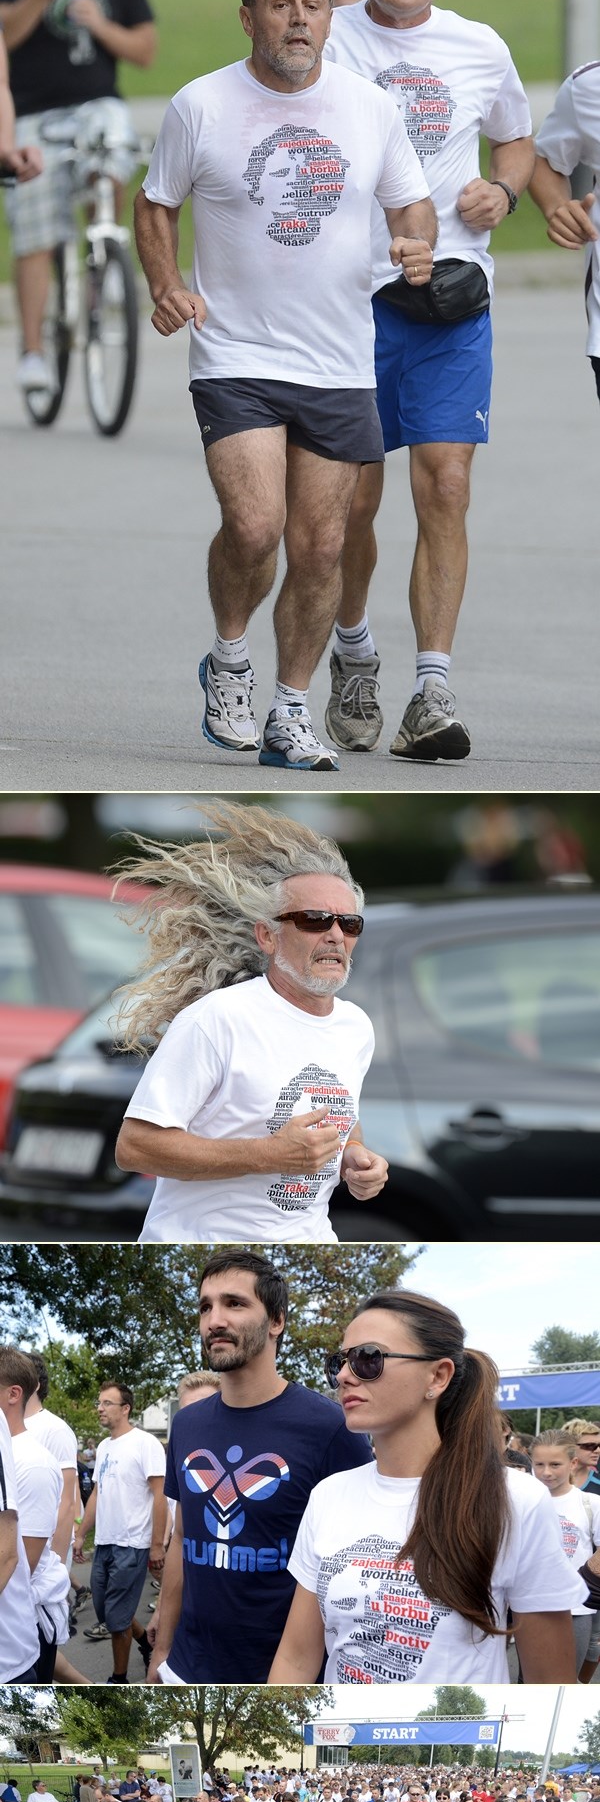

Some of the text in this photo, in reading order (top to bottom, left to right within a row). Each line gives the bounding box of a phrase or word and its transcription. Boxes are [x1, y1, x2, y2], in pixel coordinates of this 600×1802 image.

[391, 77, 443, 85] zajedničkim
[401, 84, 439, 93] working
[420, 105, 448, 113] borbu
[420, 123, 450, 131] protiv
[278, 138, 333, 148] zajedničkim
[287, 146, 328, 155] working
[301, 165, 340, 175] u borbu
[312, 182, 344, 194] protiv
[280, 219, 307, 228] raka
[303, 1085, 350, 1096] zajedničkim
[310, 1095, 346, 1108] working
[330, 1108, 348, 1116] belief
[284, 1183, 309, 1192] raka
[289, 1190, 317, 1199] cancer
[345, 1546, 381, 1554] sacrifice
[361, 1569, 417, 1585] working
[388, 1586, 420, 1598] belief
[383, 1594, 431, 1608] snagama
[371, 1600, 429, 1621] u borbu
[353, 1617, 390, 1630] sacrifice
[385, 1613, 437, 1631] together
[386, 1629, 431, 1650] protiv
[344, 1664, 372, 1684] raka
[372, 1727, 419, 1740] START
